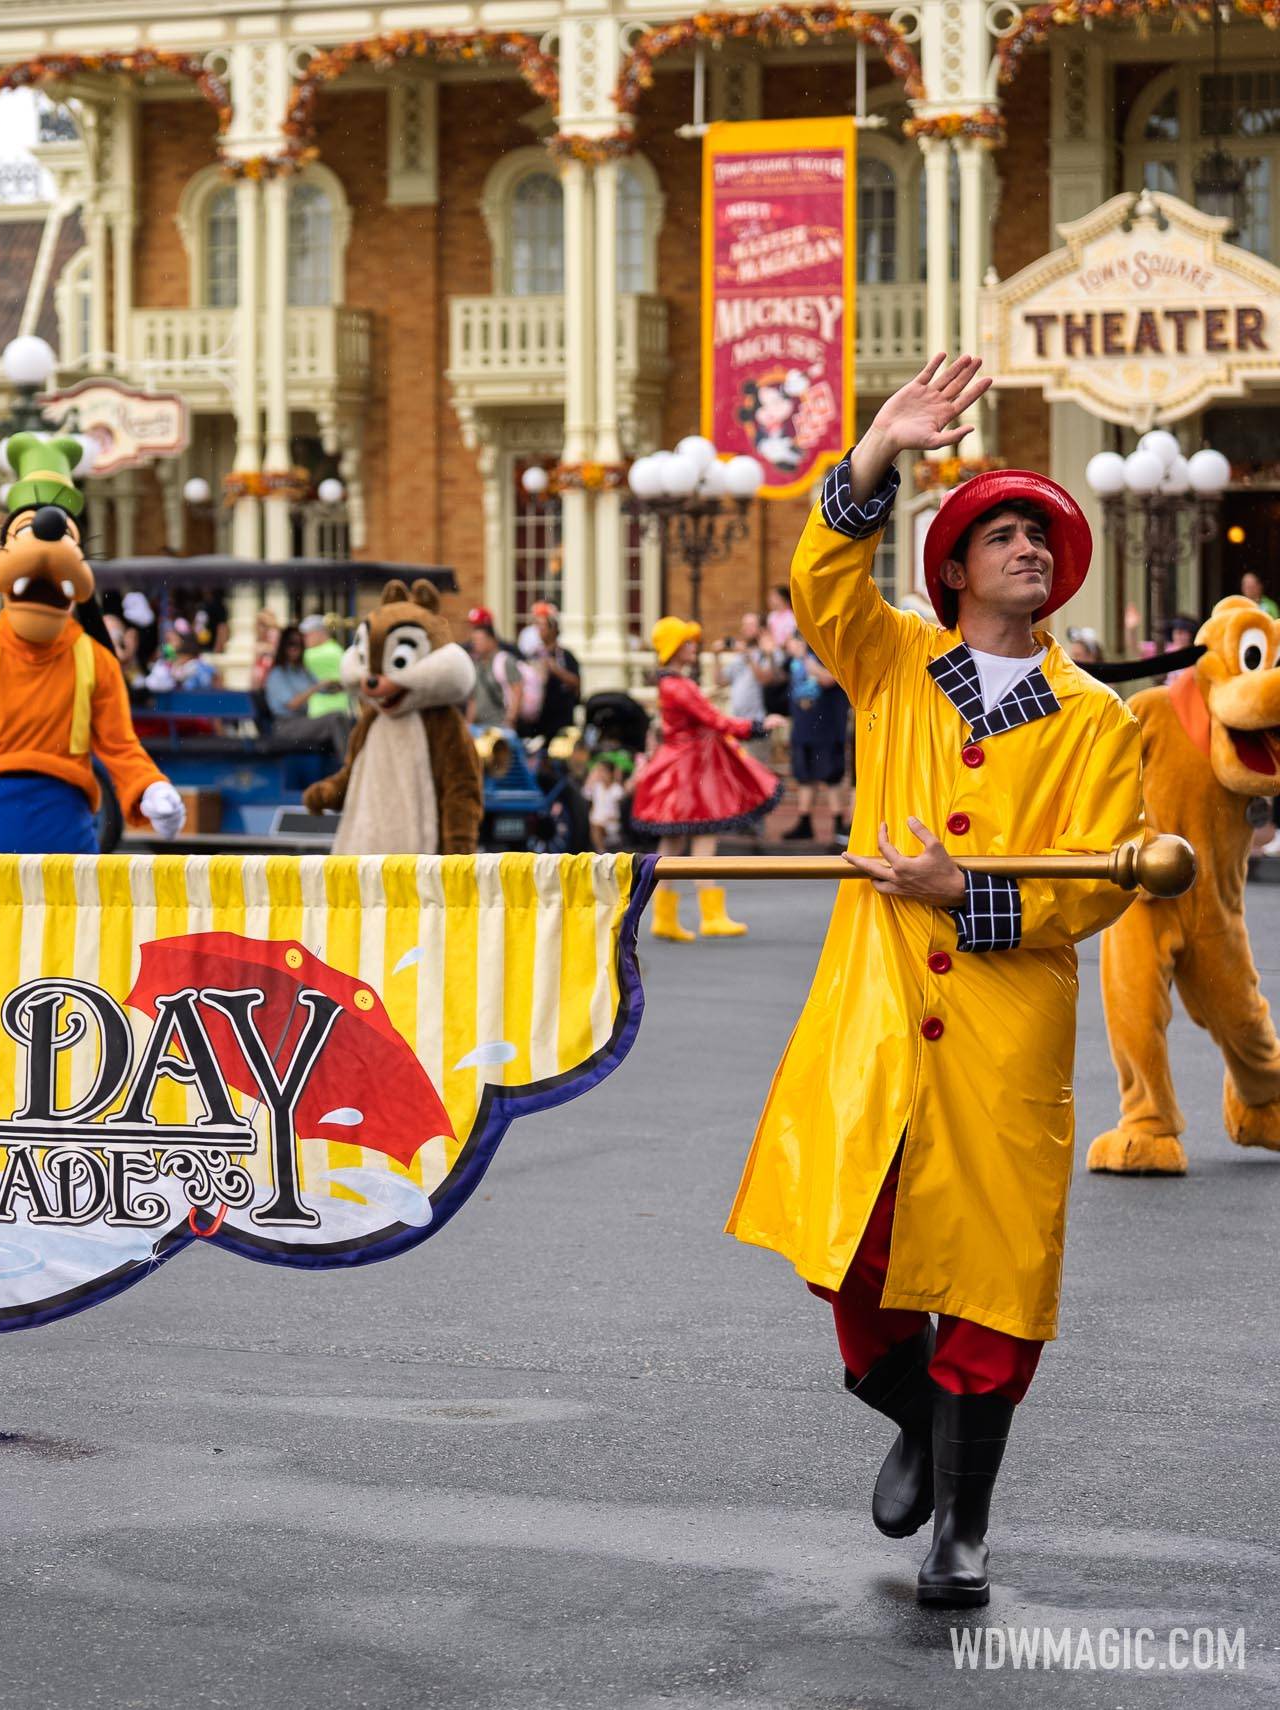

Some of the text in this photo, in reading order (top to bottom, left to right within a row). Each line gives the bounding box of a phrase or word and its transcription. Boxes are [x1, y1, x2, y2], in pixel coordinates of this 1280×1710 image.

[714, 295, 842, 347] MICKEY
[1024, 303, 1269, 359] THEATER
[731, 334, 825, 368] MOUSE
[1, 977, 345, 1227] DAY
